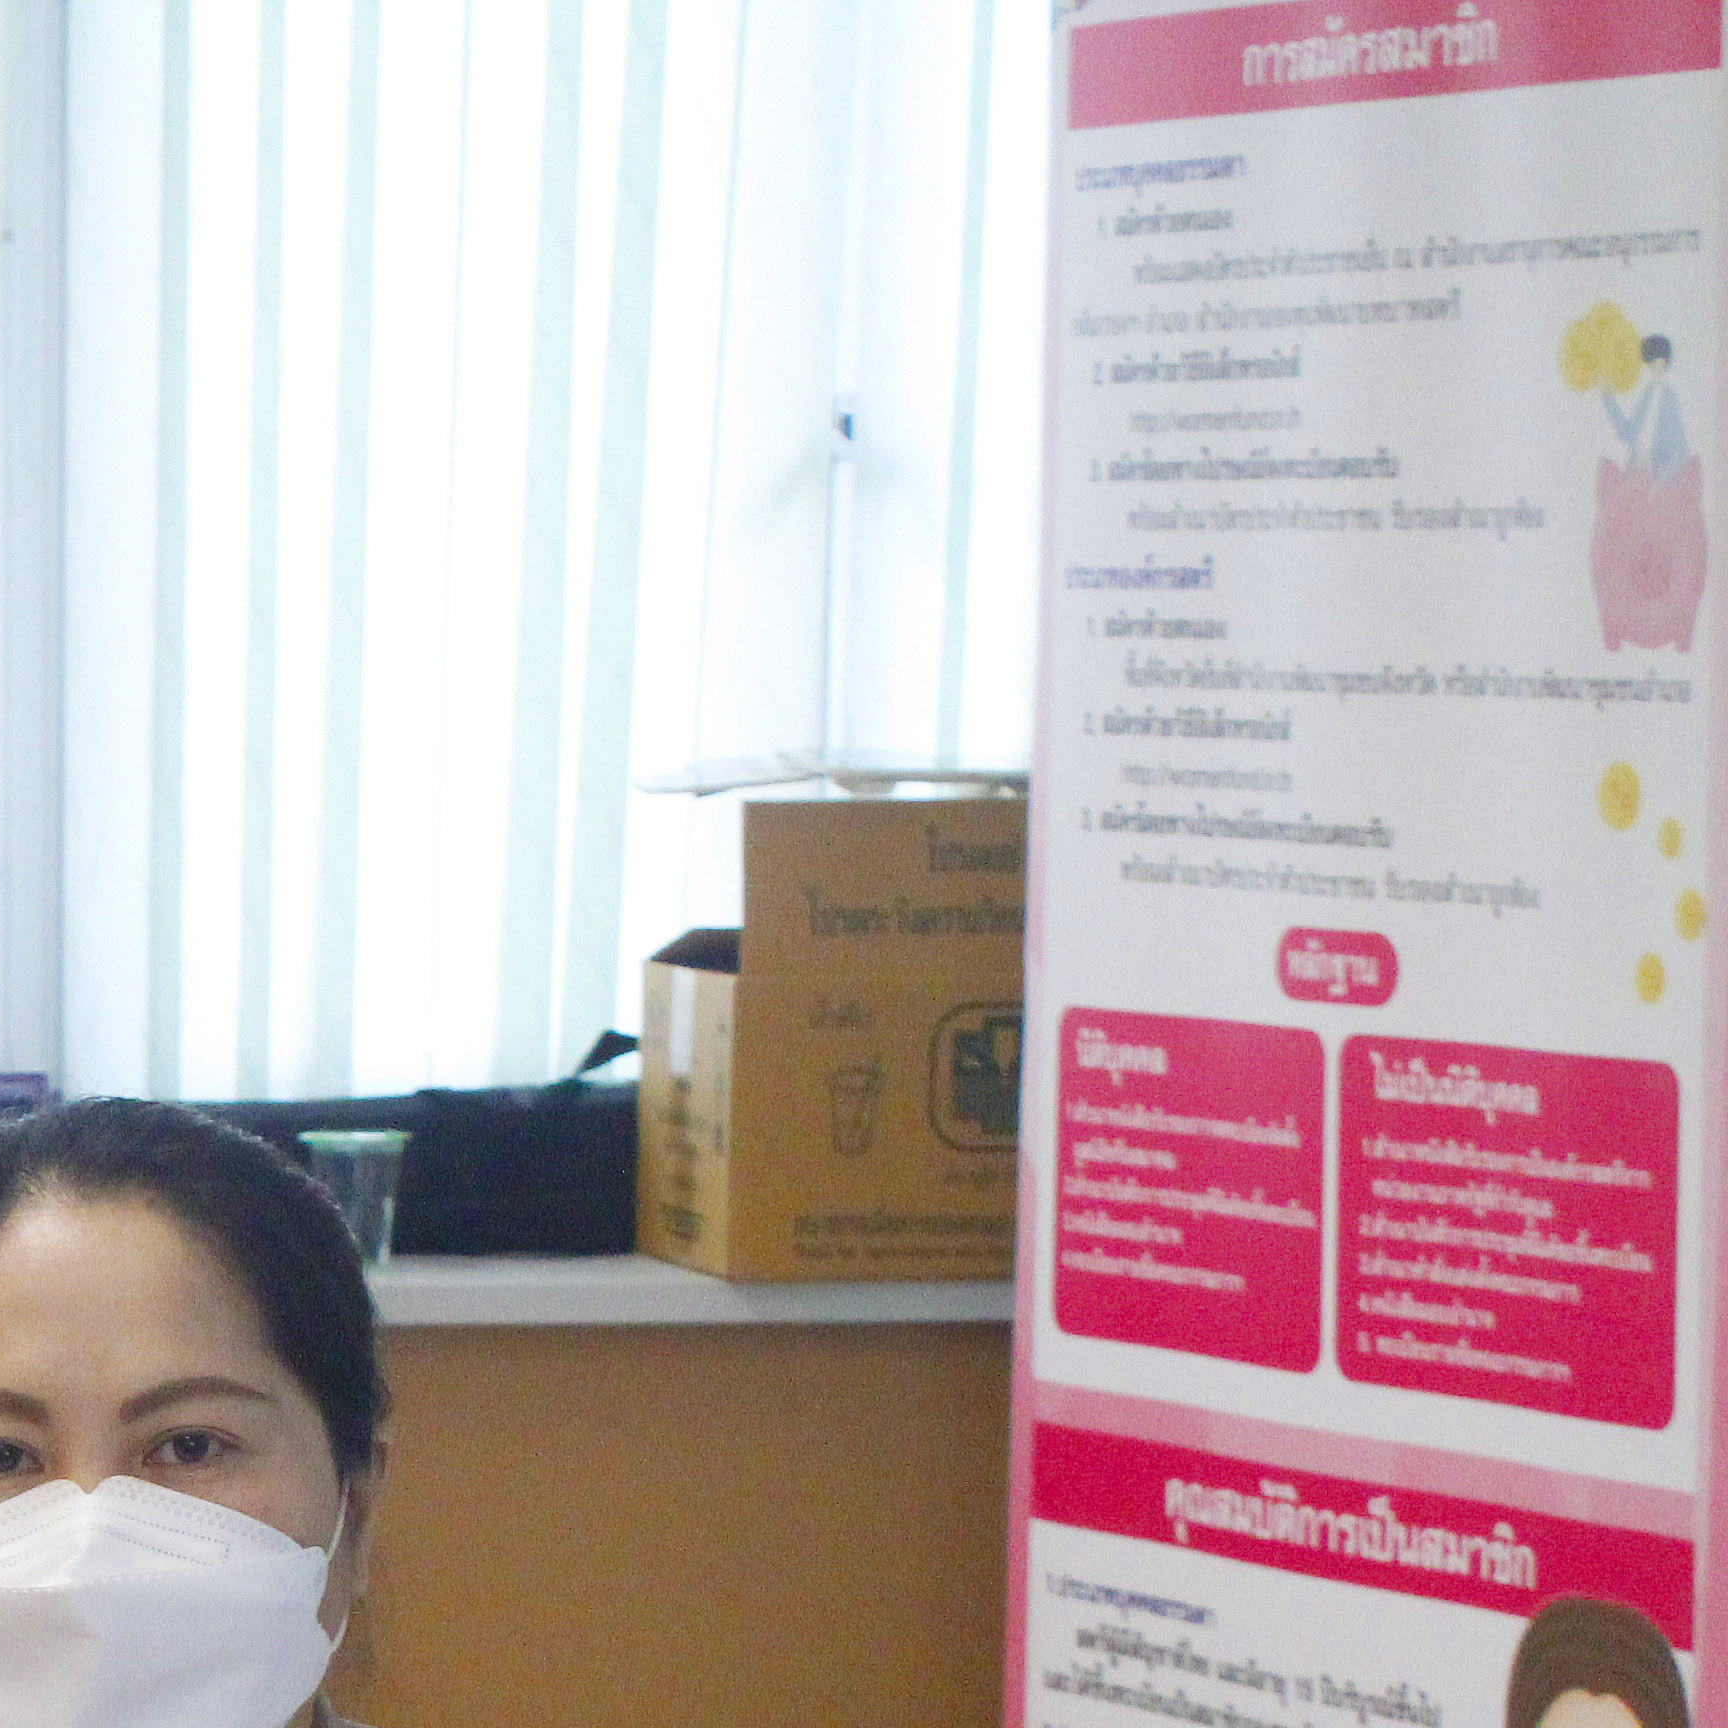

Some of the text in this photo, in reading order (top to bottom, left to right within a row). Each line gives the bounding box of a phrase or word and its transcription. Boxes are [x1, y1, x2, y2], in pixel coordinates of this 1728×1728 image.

[1243, 3, 1500, 89] การสมัครสมาชิก
[1164, 1475, 1537, 1591] คุณสมบัติการเป็นสมาชิก
